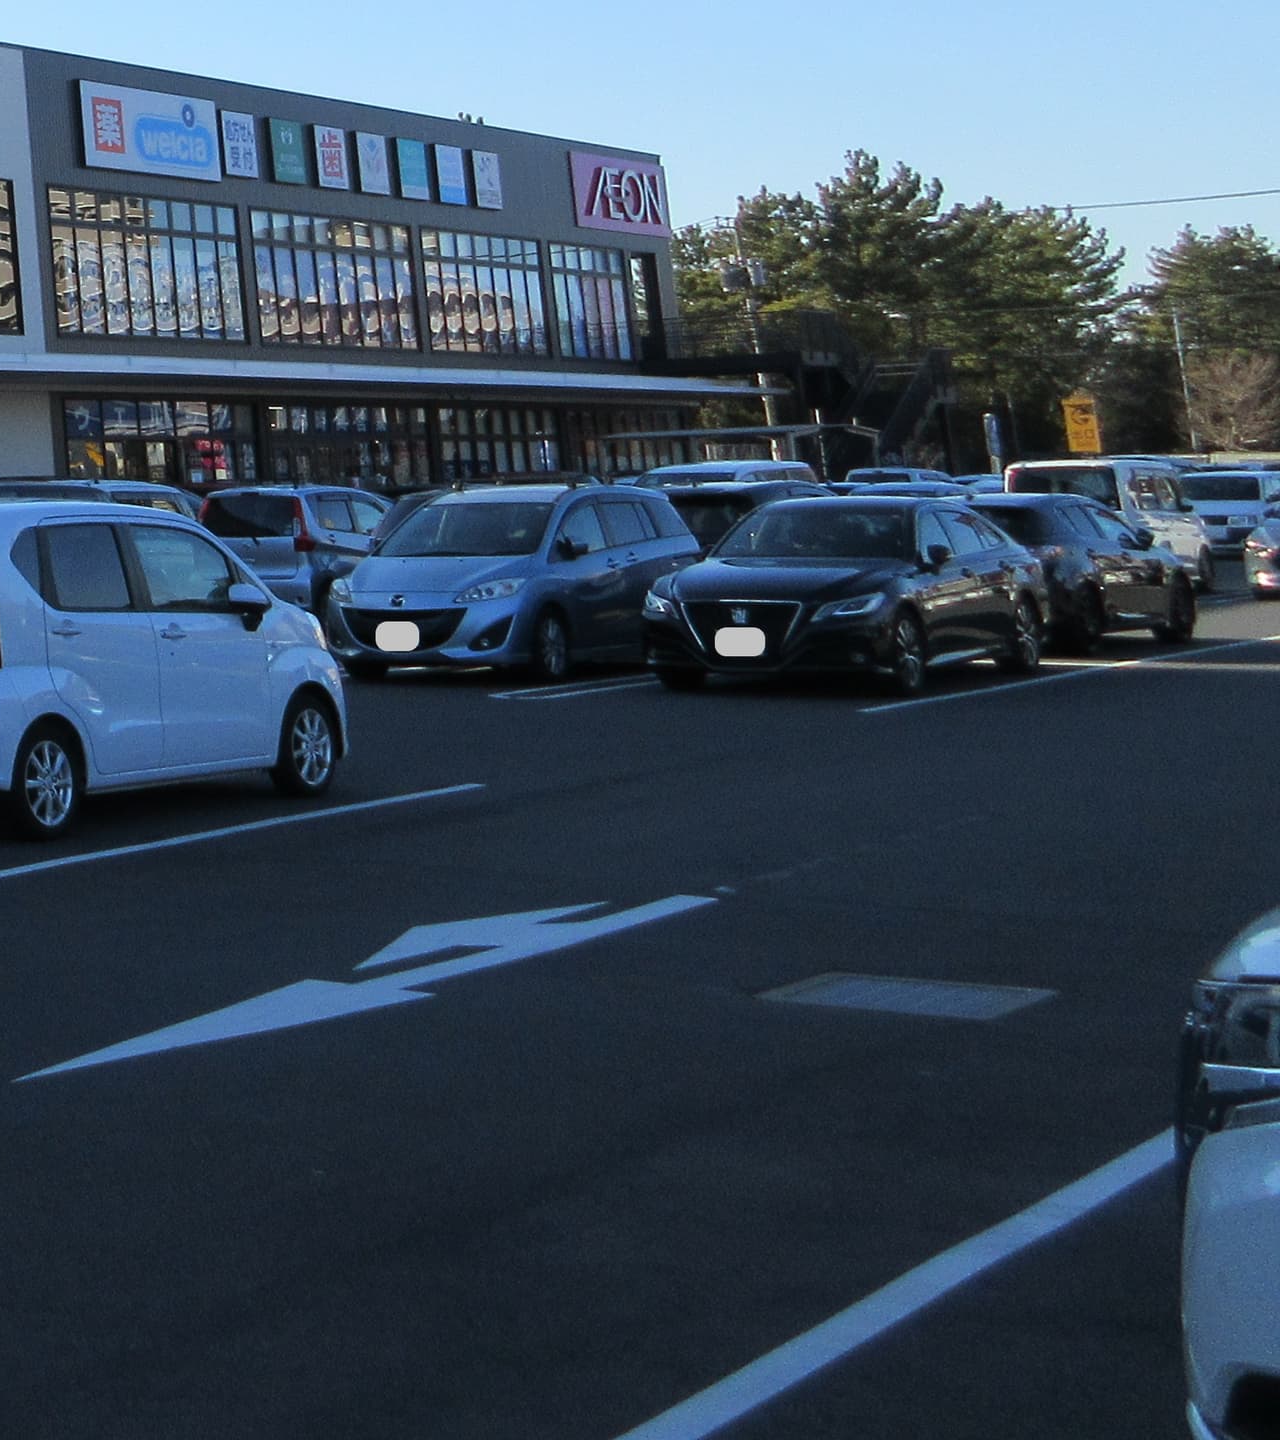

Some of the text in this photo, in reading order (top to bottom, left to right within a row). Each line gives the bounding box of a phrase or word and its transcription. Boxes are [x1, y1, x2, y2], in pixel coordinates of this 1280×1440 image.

[96, 103, 121, 147] 薬
[230, 146, 253, 171] 受付
[319, 130, 344, 178] 歯
